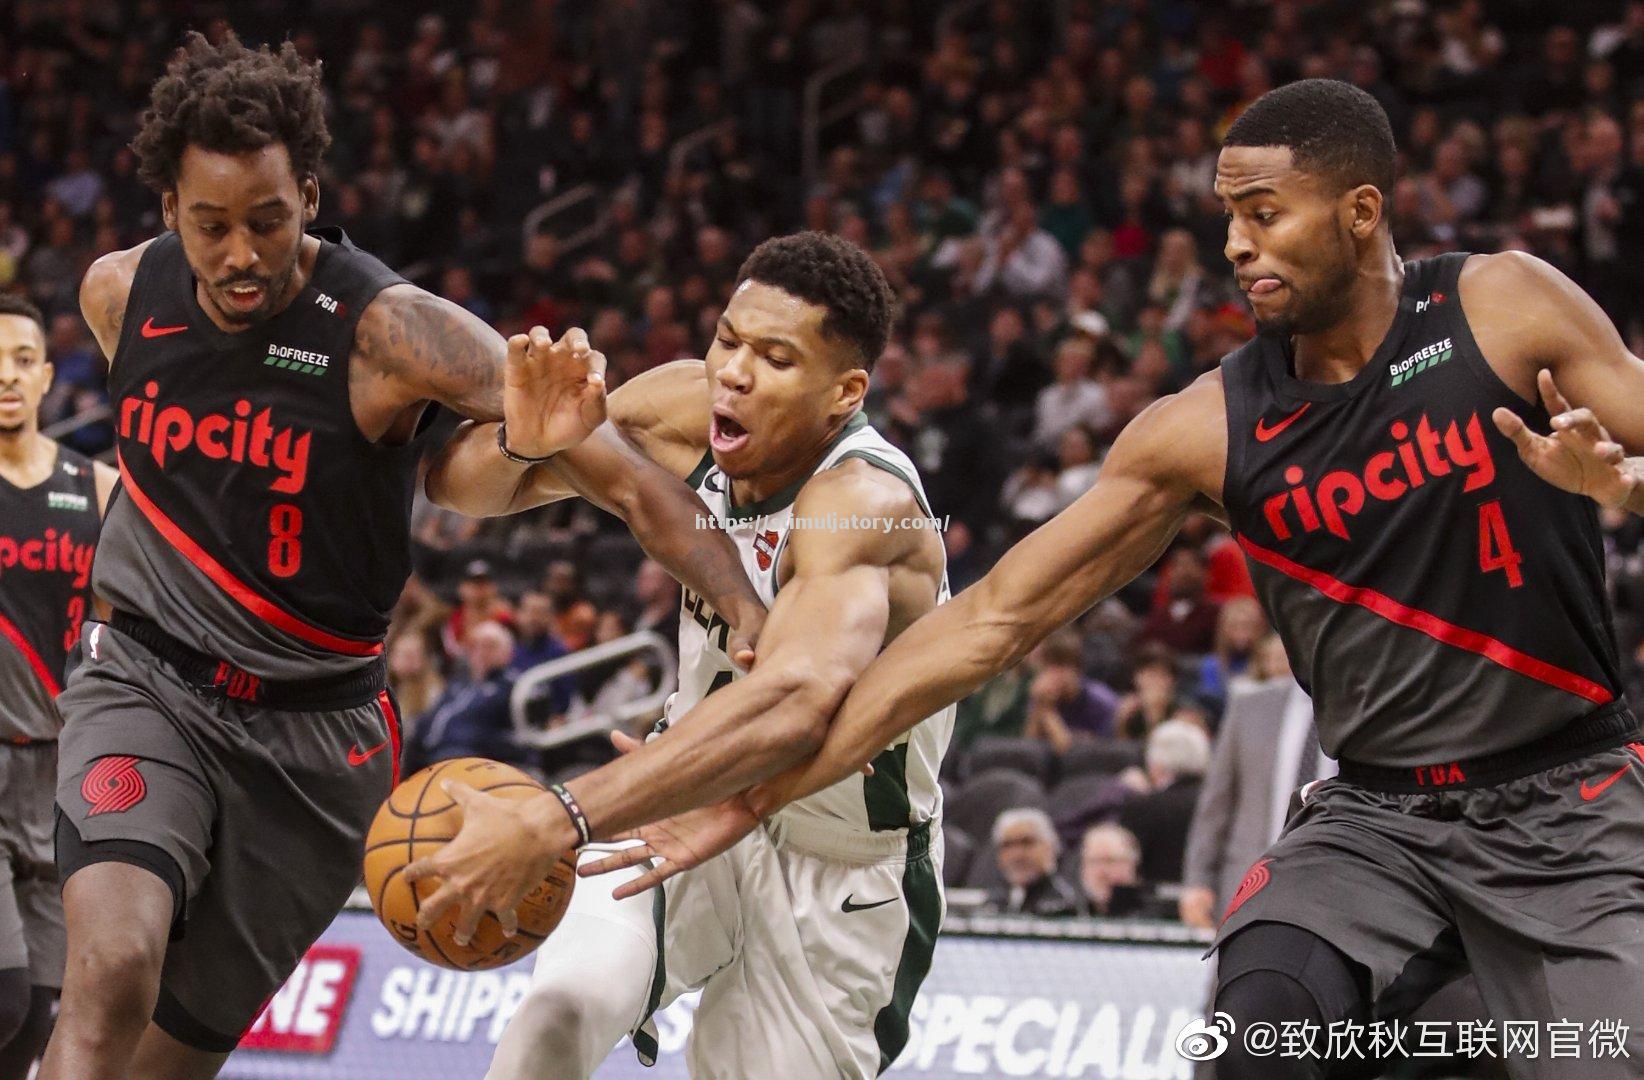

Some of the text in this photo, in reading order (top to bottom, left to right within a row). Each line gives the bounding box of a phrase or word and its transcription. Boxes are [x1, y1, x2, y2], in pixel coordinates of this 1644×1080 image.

[315, 293, 339, 314] PGA
[120, 380, 312, 494] ripcity
[1263, 411, 1496, 541] ripcity
[267, 503, 303, 578] 8
[1478, 500, 1524, 589] 4
